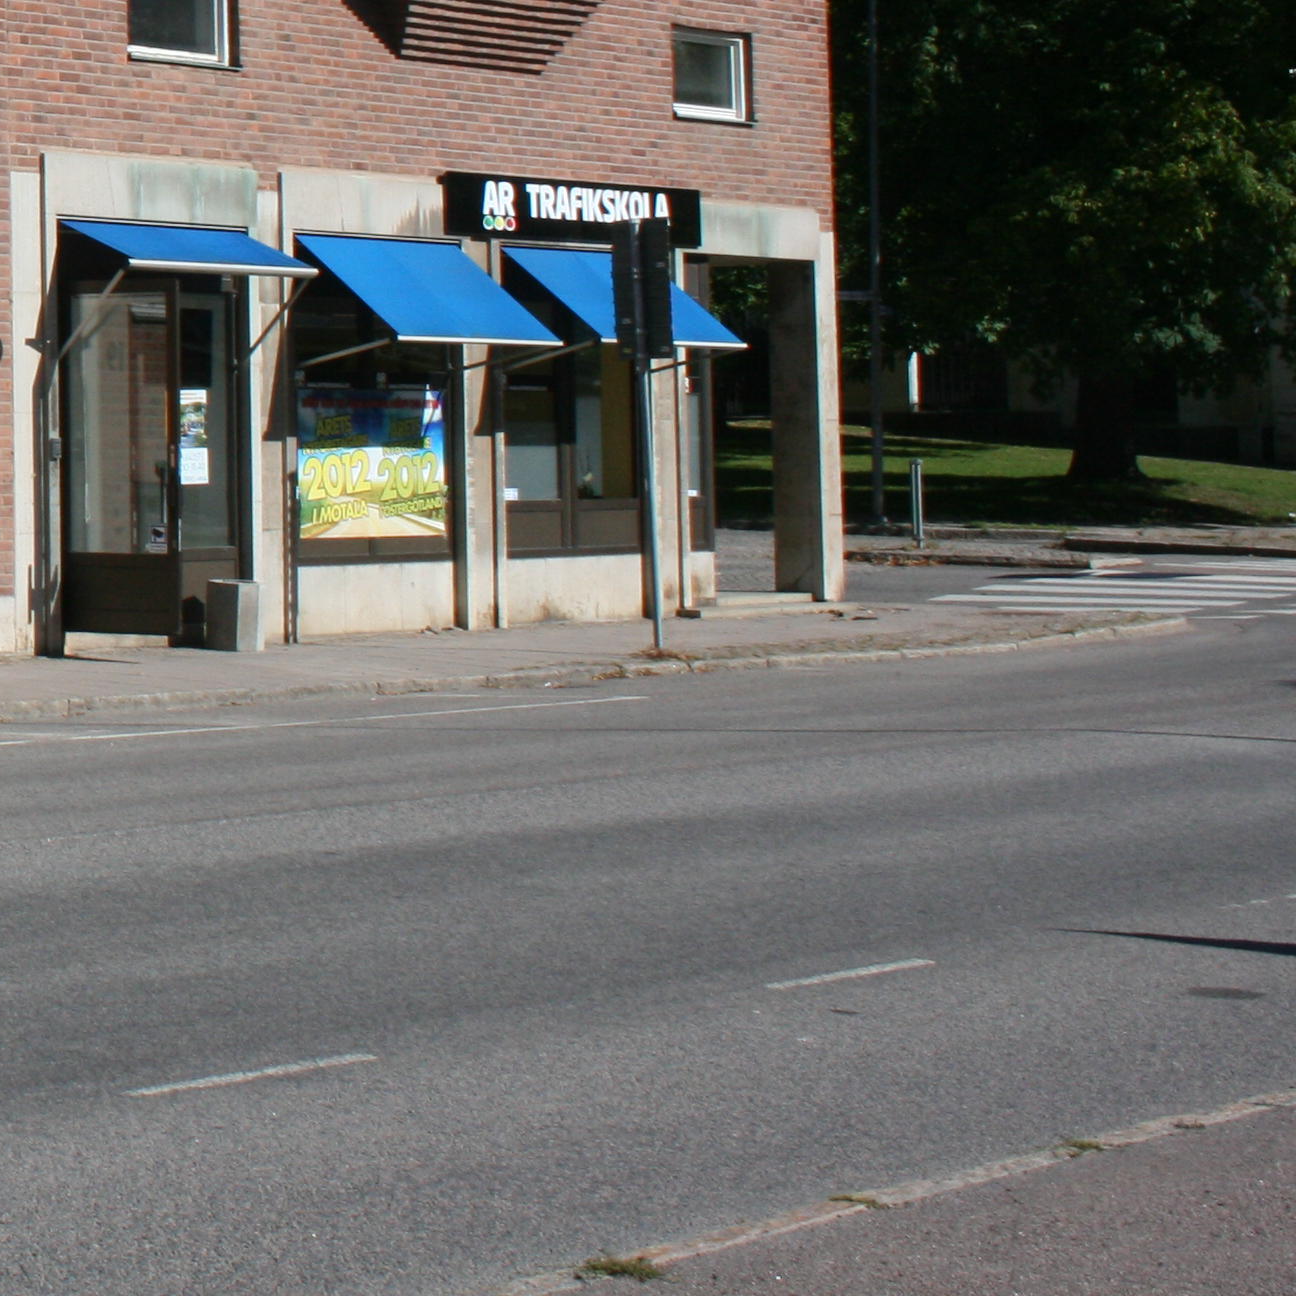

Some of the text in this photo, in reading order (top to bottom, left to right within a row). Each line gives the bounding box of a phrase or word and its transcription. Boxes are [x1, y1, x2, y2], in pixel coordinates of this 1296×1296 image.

[483, 180, 670, 223] AR TRAFIKSKOLA
[303, 449, 372, 502] 2012
[378, 452, 441, 502] 2012
[319, 499, 369, 524] MOTALA
